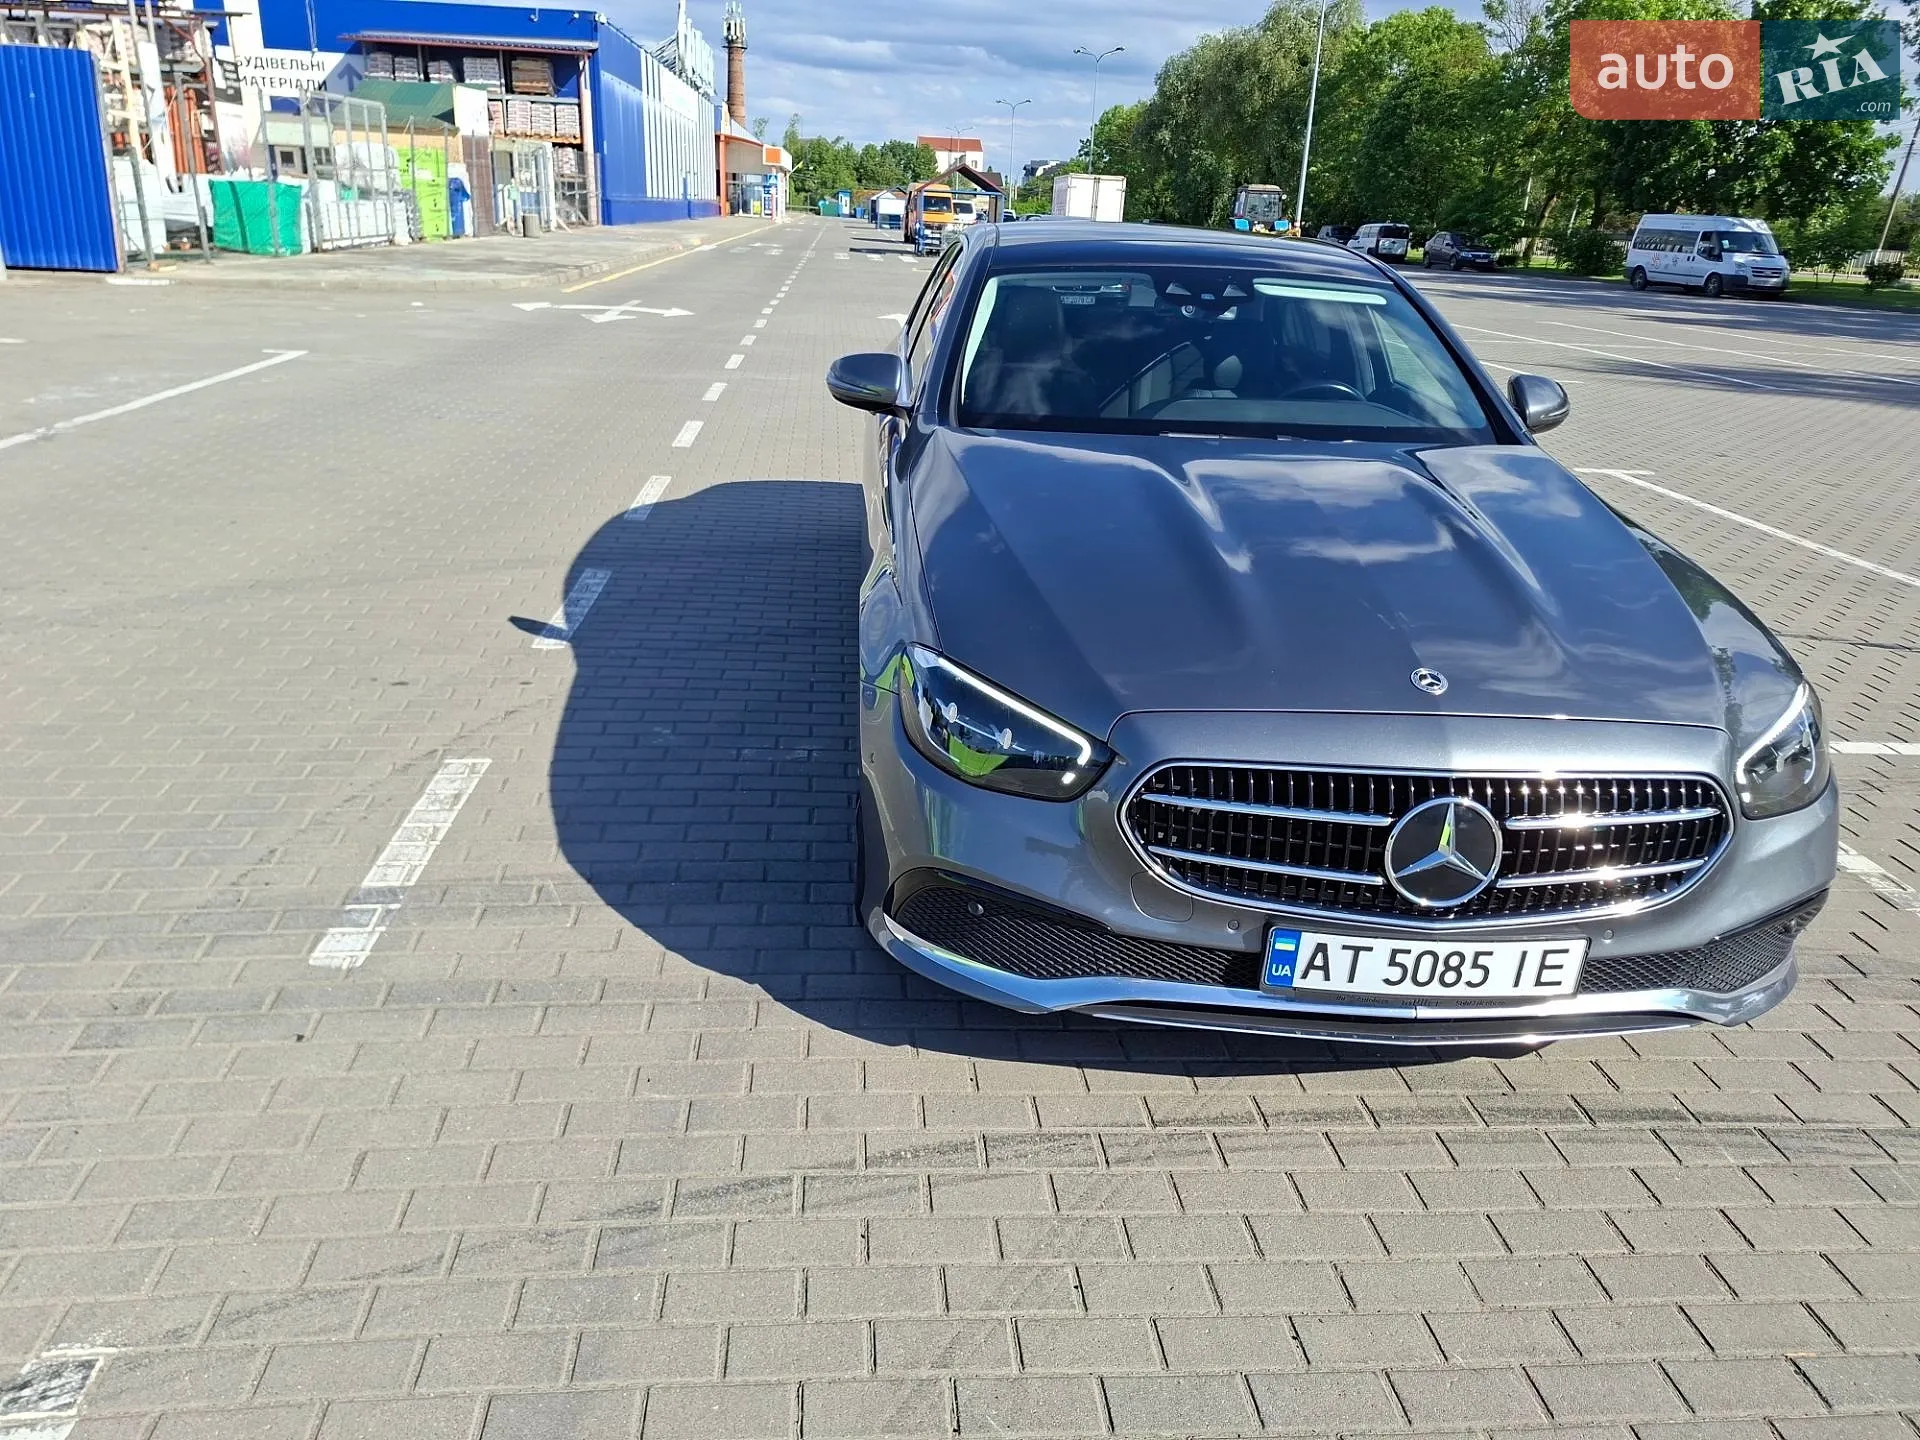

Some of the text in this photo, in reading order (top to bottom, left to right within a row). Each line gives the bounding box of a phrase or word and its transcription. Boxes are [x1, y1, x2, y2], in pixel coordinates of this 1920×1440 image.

[1271, 962, 1292, 977] UA
[1300, 942, 1570, 988] AT 5085 IE
